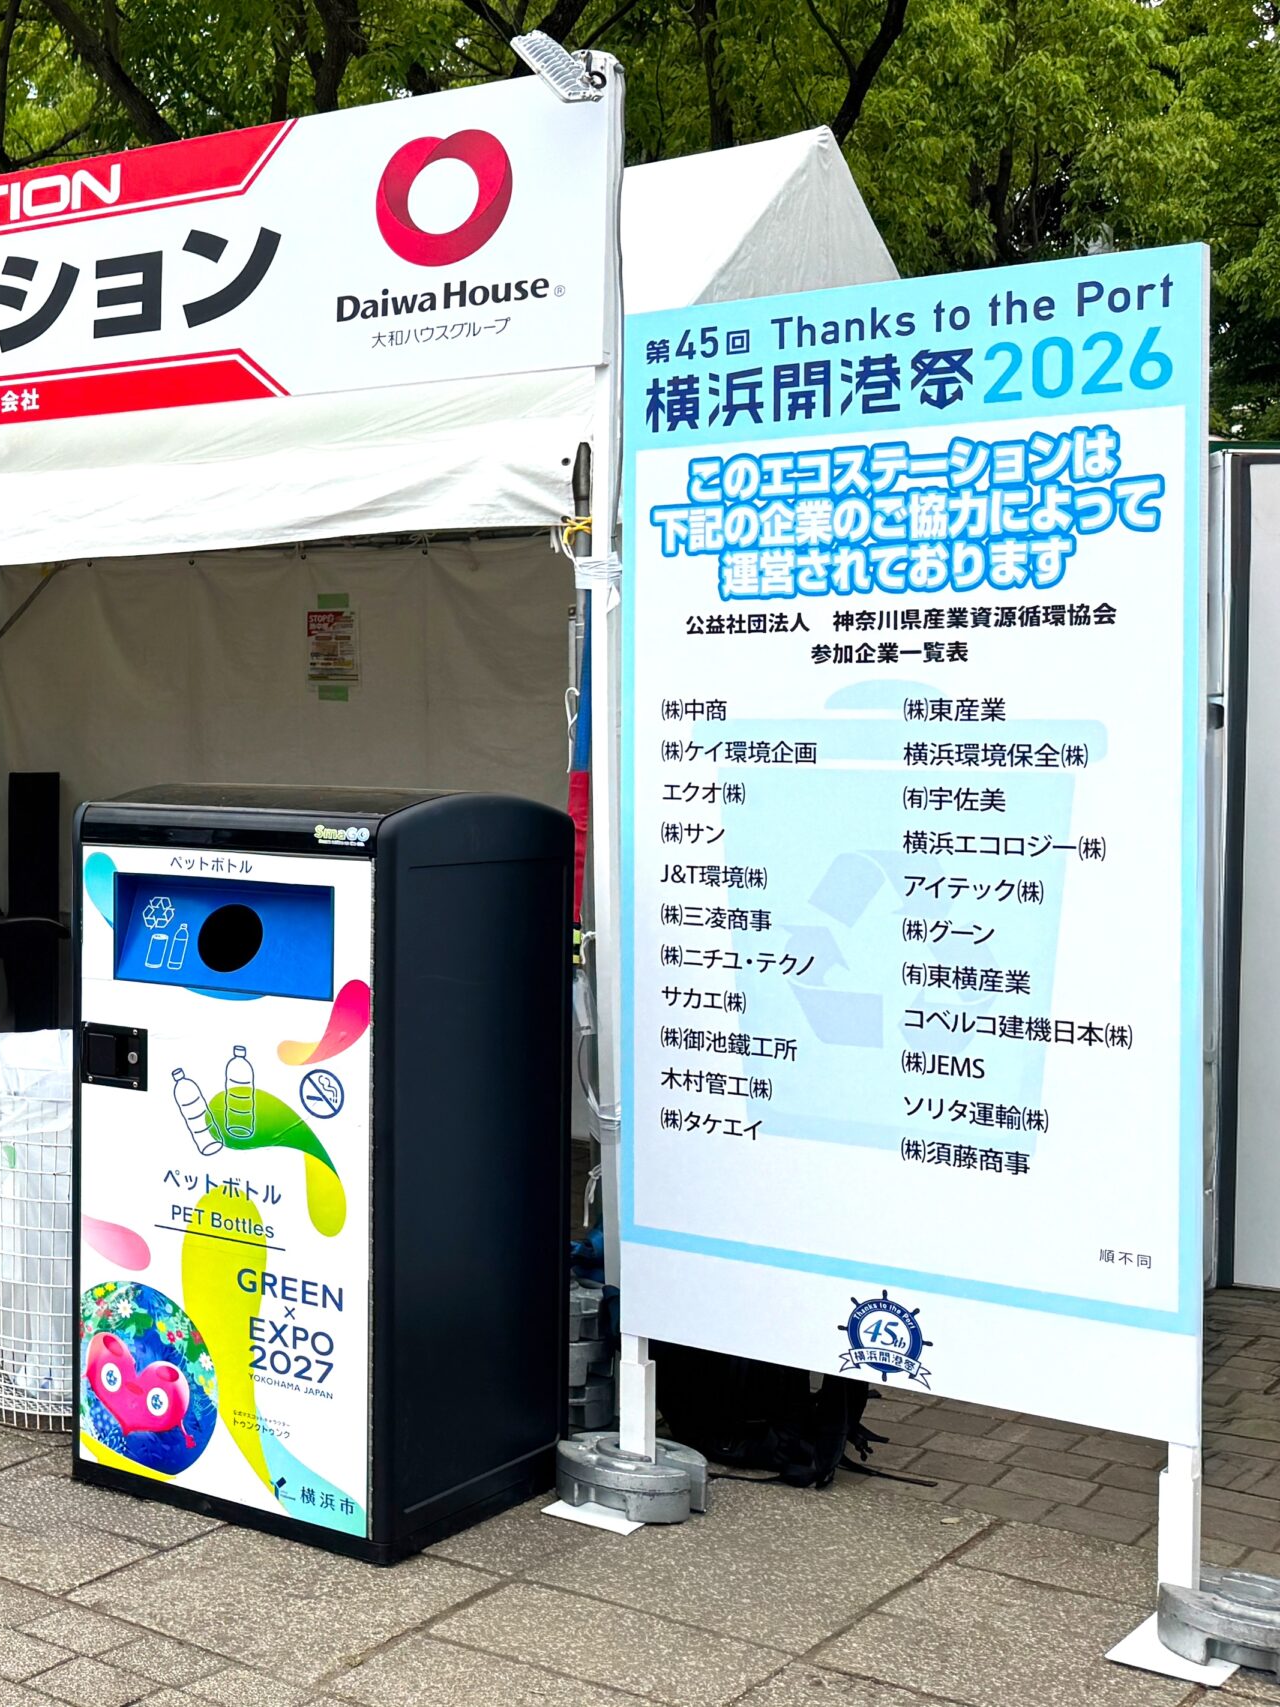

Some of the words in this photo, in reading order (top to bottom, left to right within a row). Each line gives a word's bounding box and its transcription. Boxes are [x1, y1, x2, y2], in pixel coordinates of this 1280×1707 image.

[337, 288, 437, 322] Daiwa
[443, 278, 550, 309] House
[371, 316, 511, 348] 大和ハウスグループ
[646, 326, 751, 364] 第45回
[771, 307, 916, 350] Thanks
[933, 300, 971, 333] to
[989, 291, 1056, 327] the
[1076, 273, 1174, 317] Port
[687, 424, 1121, 502] このエコステーションは
[651, 475, 1165, 557] 下記の企業のご協力によって
[718, 535, 1077, 601] 運営されております
[685, 613, 811, 635] 公益社団法人
[832, 602, 1117, 632] 神奈川県産業資源循環協会
[811, 641, 969, 664] 参加企業一覧表
[169, 855, 253, 875] ペットボトル
[163, 1169, 282, 1206] ペットボトル
[171, 1204, 206, 1226] PET
[210, 1212, 275, 1239] Bottles
[1099, 1249, 1152, 1269] 順不同
[237, 1268, 343, 1312] GREEN
[249, 1316, 334, 1357] EXPO
[863, 1319, 906, 1349] 45th
[248, 1344, 334, 1384] 2027
[854, 1350, 916, 1371] 横浜開港祭
[248, 1372, 301, 1392] YOKOHAMA
[303, 1385, 334, 1400] JAPAN
[300, 1486, 356, 1517] 横浜市
